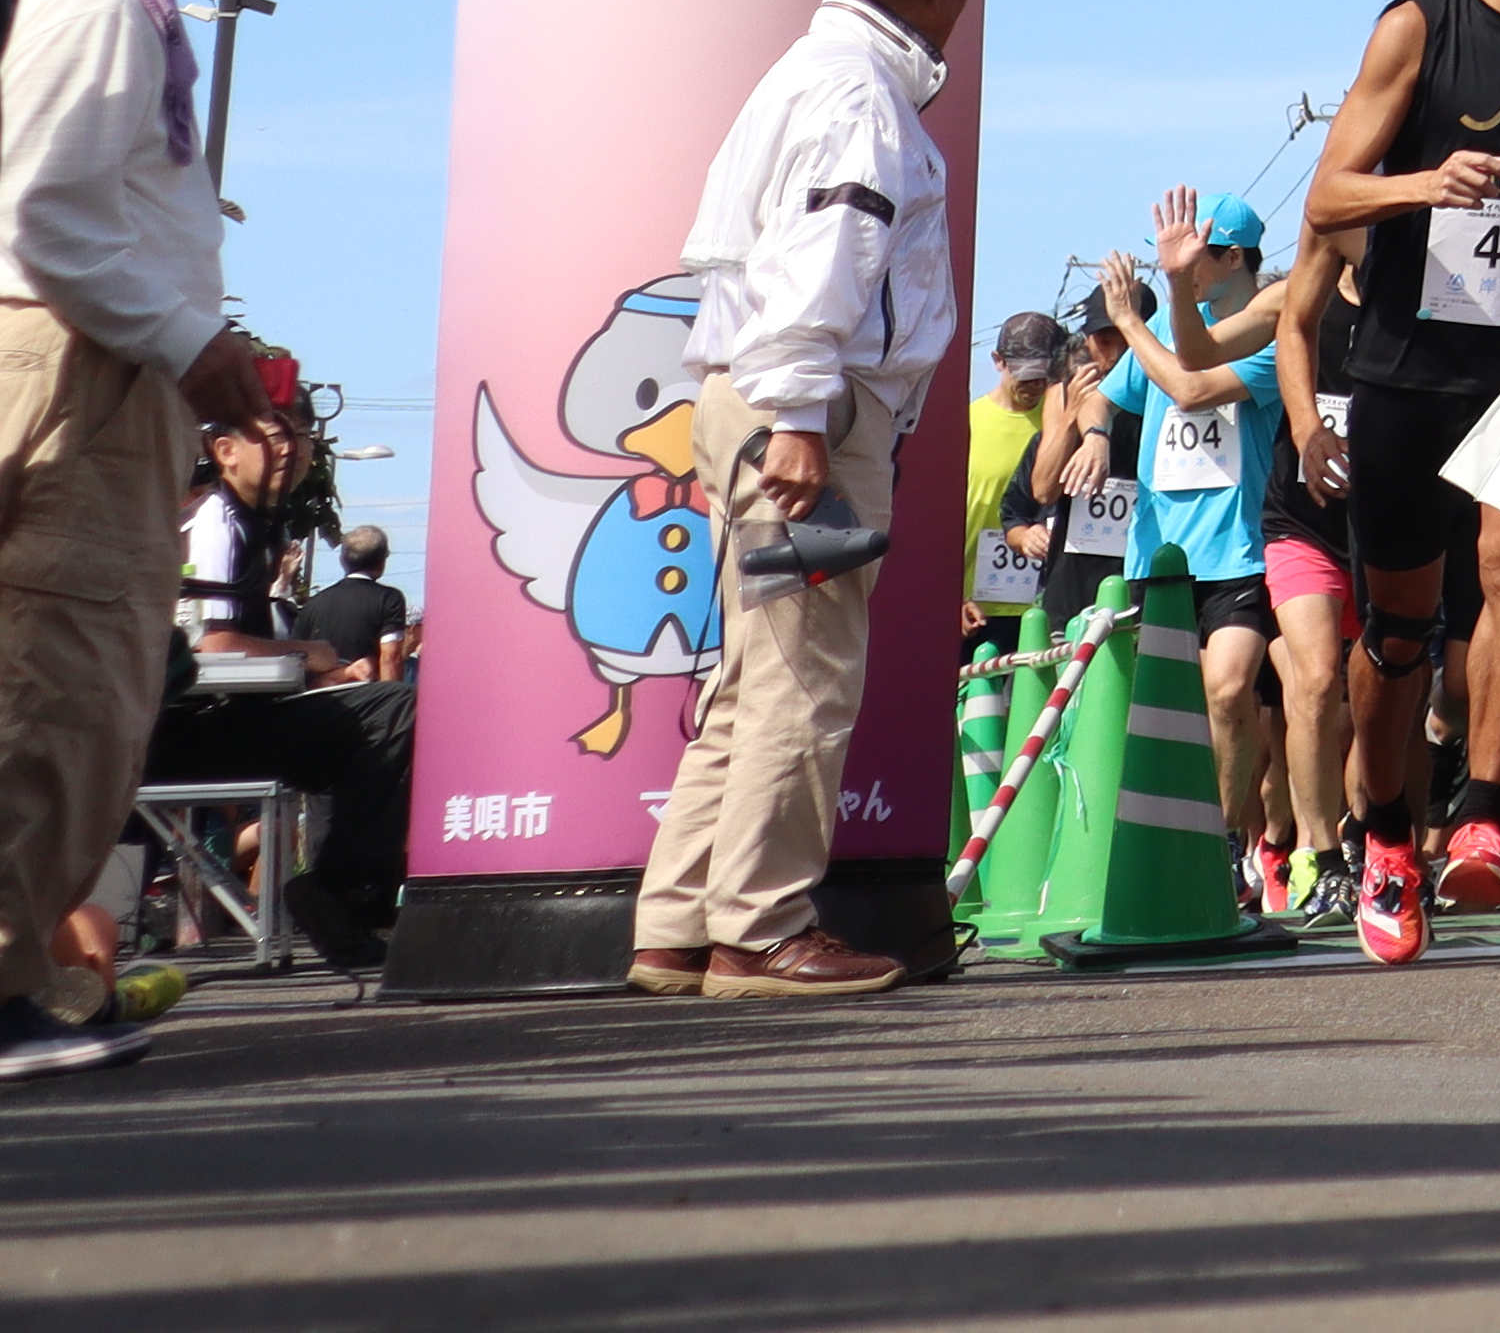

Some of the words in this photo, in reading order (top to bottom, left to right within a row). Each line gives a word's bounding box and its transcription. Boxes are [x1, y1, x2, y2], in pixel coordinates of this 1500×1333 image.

[1165, 419, 1222, 451] 404
[1088, 493, 1139, 522] 60
[443, 790, 553, 842] 美唄市
